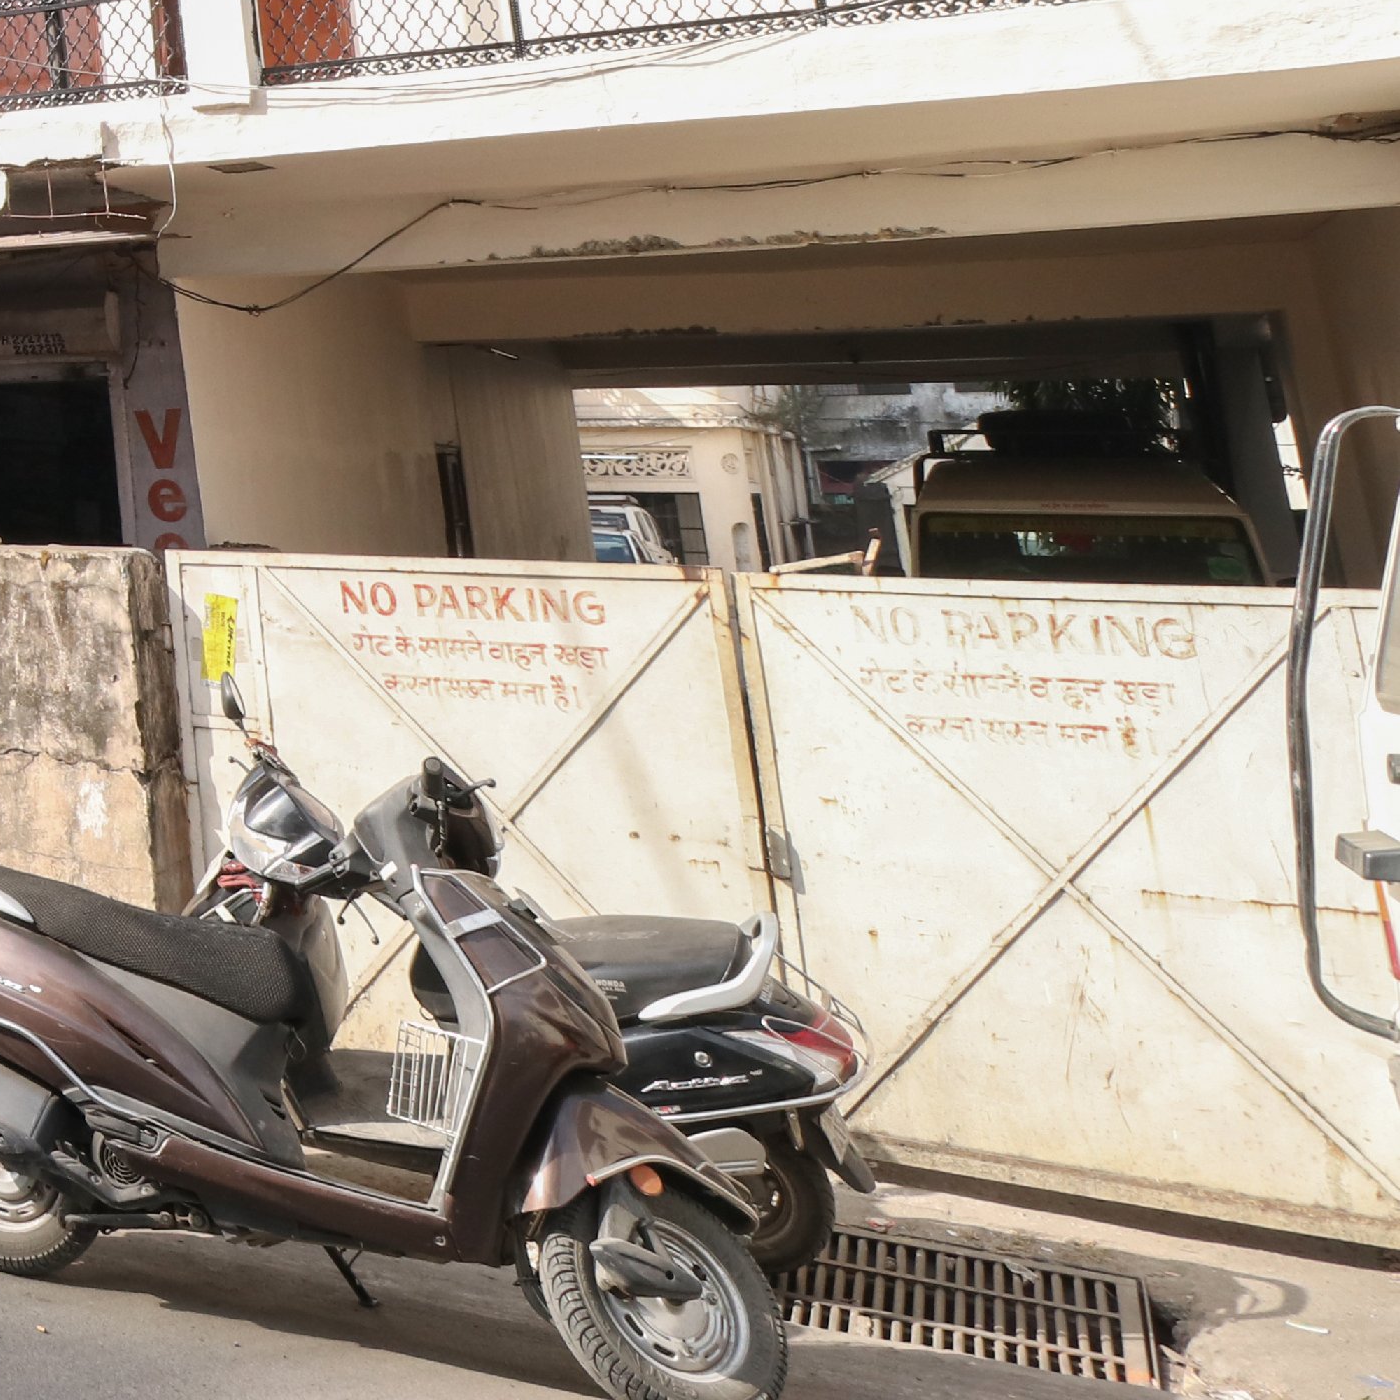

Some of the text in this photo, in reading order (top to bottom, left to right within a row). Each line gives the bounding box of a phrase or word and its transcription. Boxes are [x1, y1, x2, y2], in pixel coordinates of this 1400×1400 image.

[340, 580, 605, 625] NO PARKING
[851, 605, 921, 645] NO
[489, 641, 548, 672] वाहन
